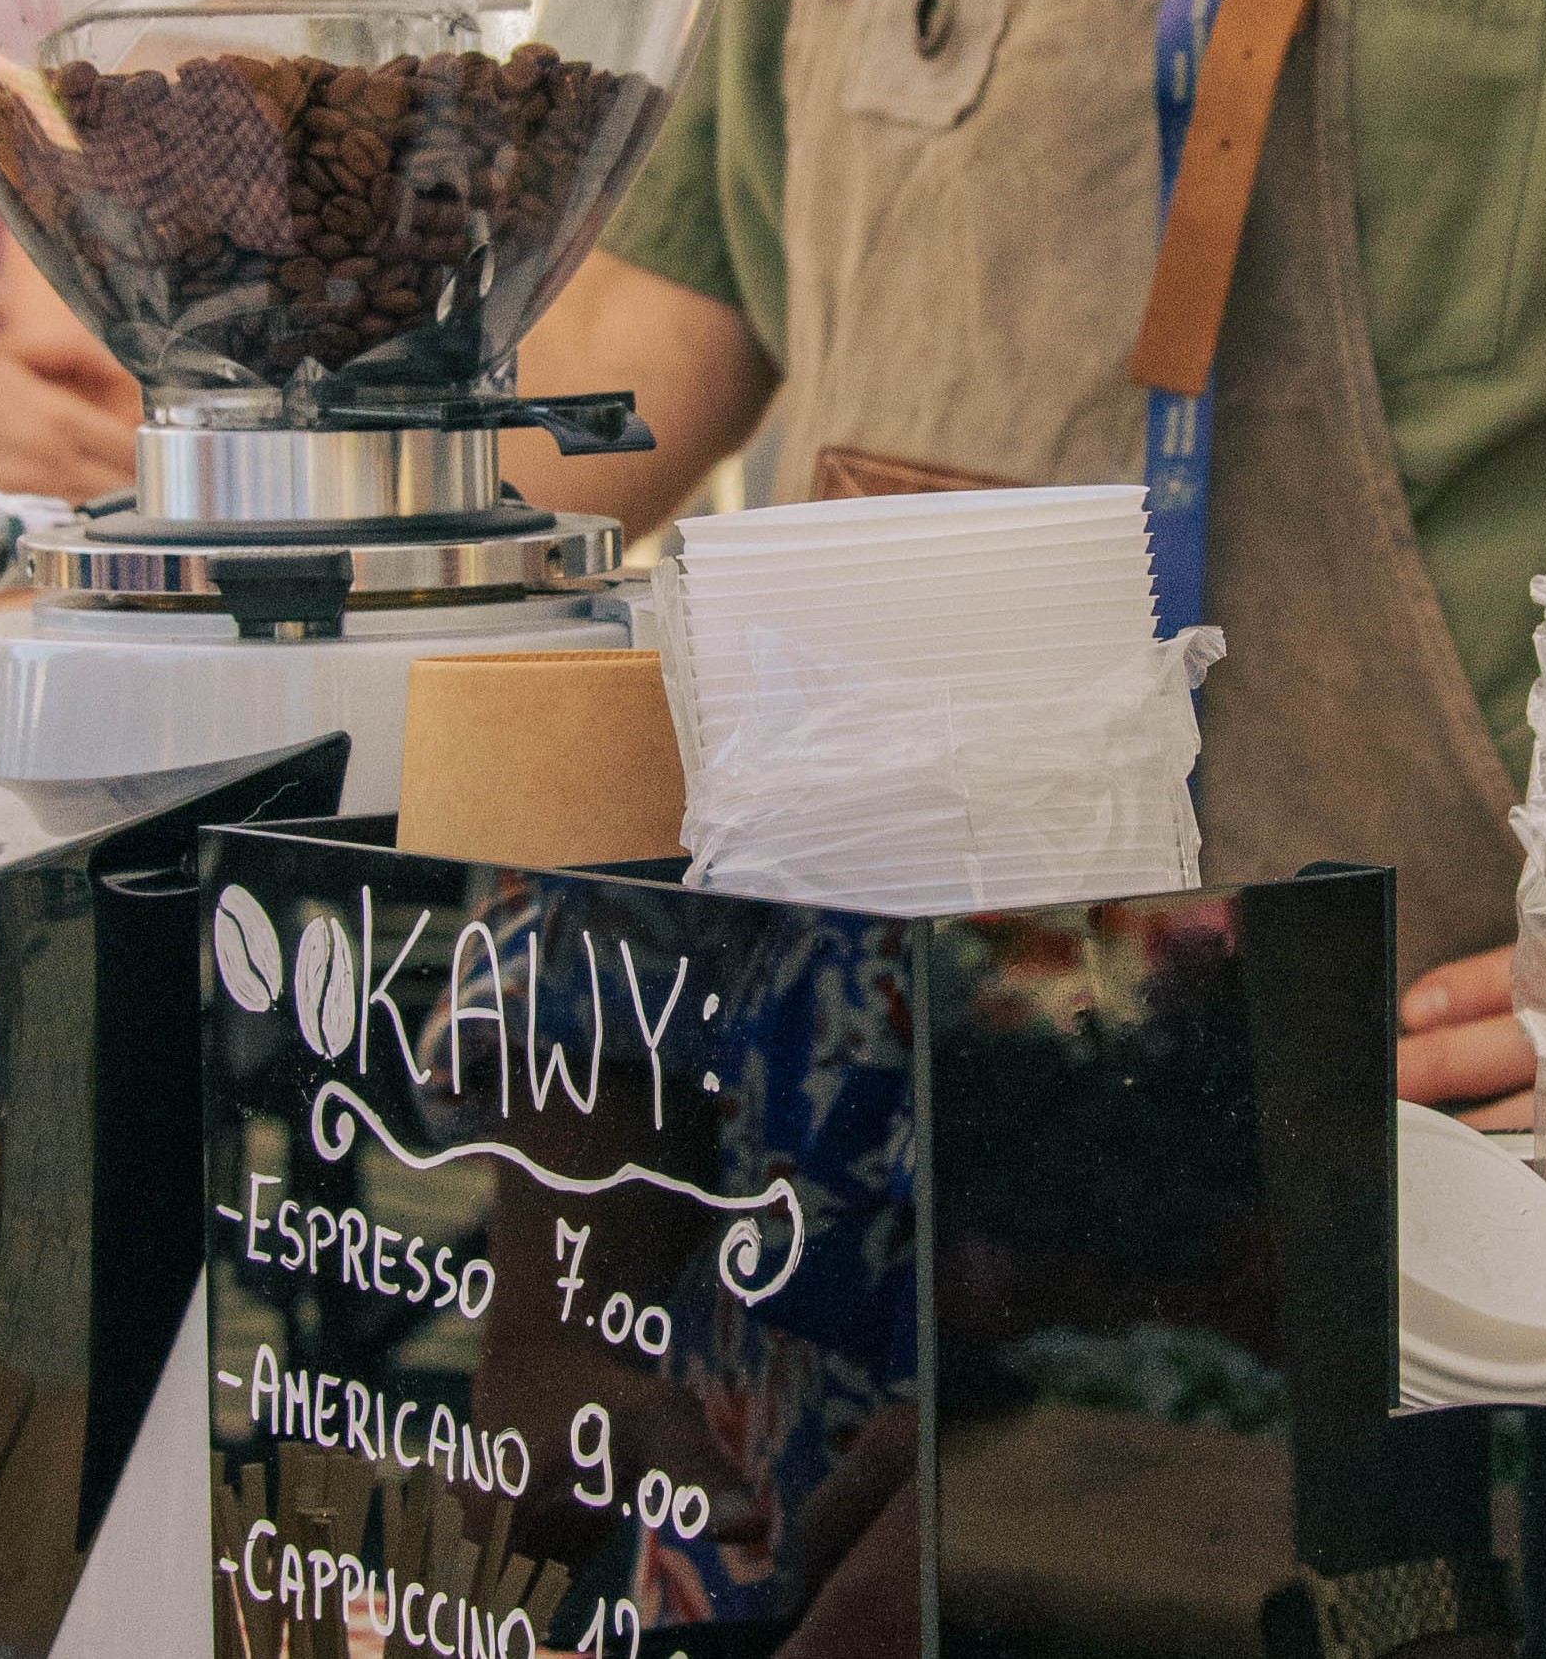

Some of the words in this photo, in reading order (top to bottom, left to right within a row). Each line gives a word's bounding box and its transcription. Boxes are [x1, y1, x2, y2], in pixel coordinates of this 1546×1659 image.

[359, 885, 720, 1130] KAWY:
[554, 1216, 672, 1356] 7.00
[569, 1402, 710, 1539] 9.00
